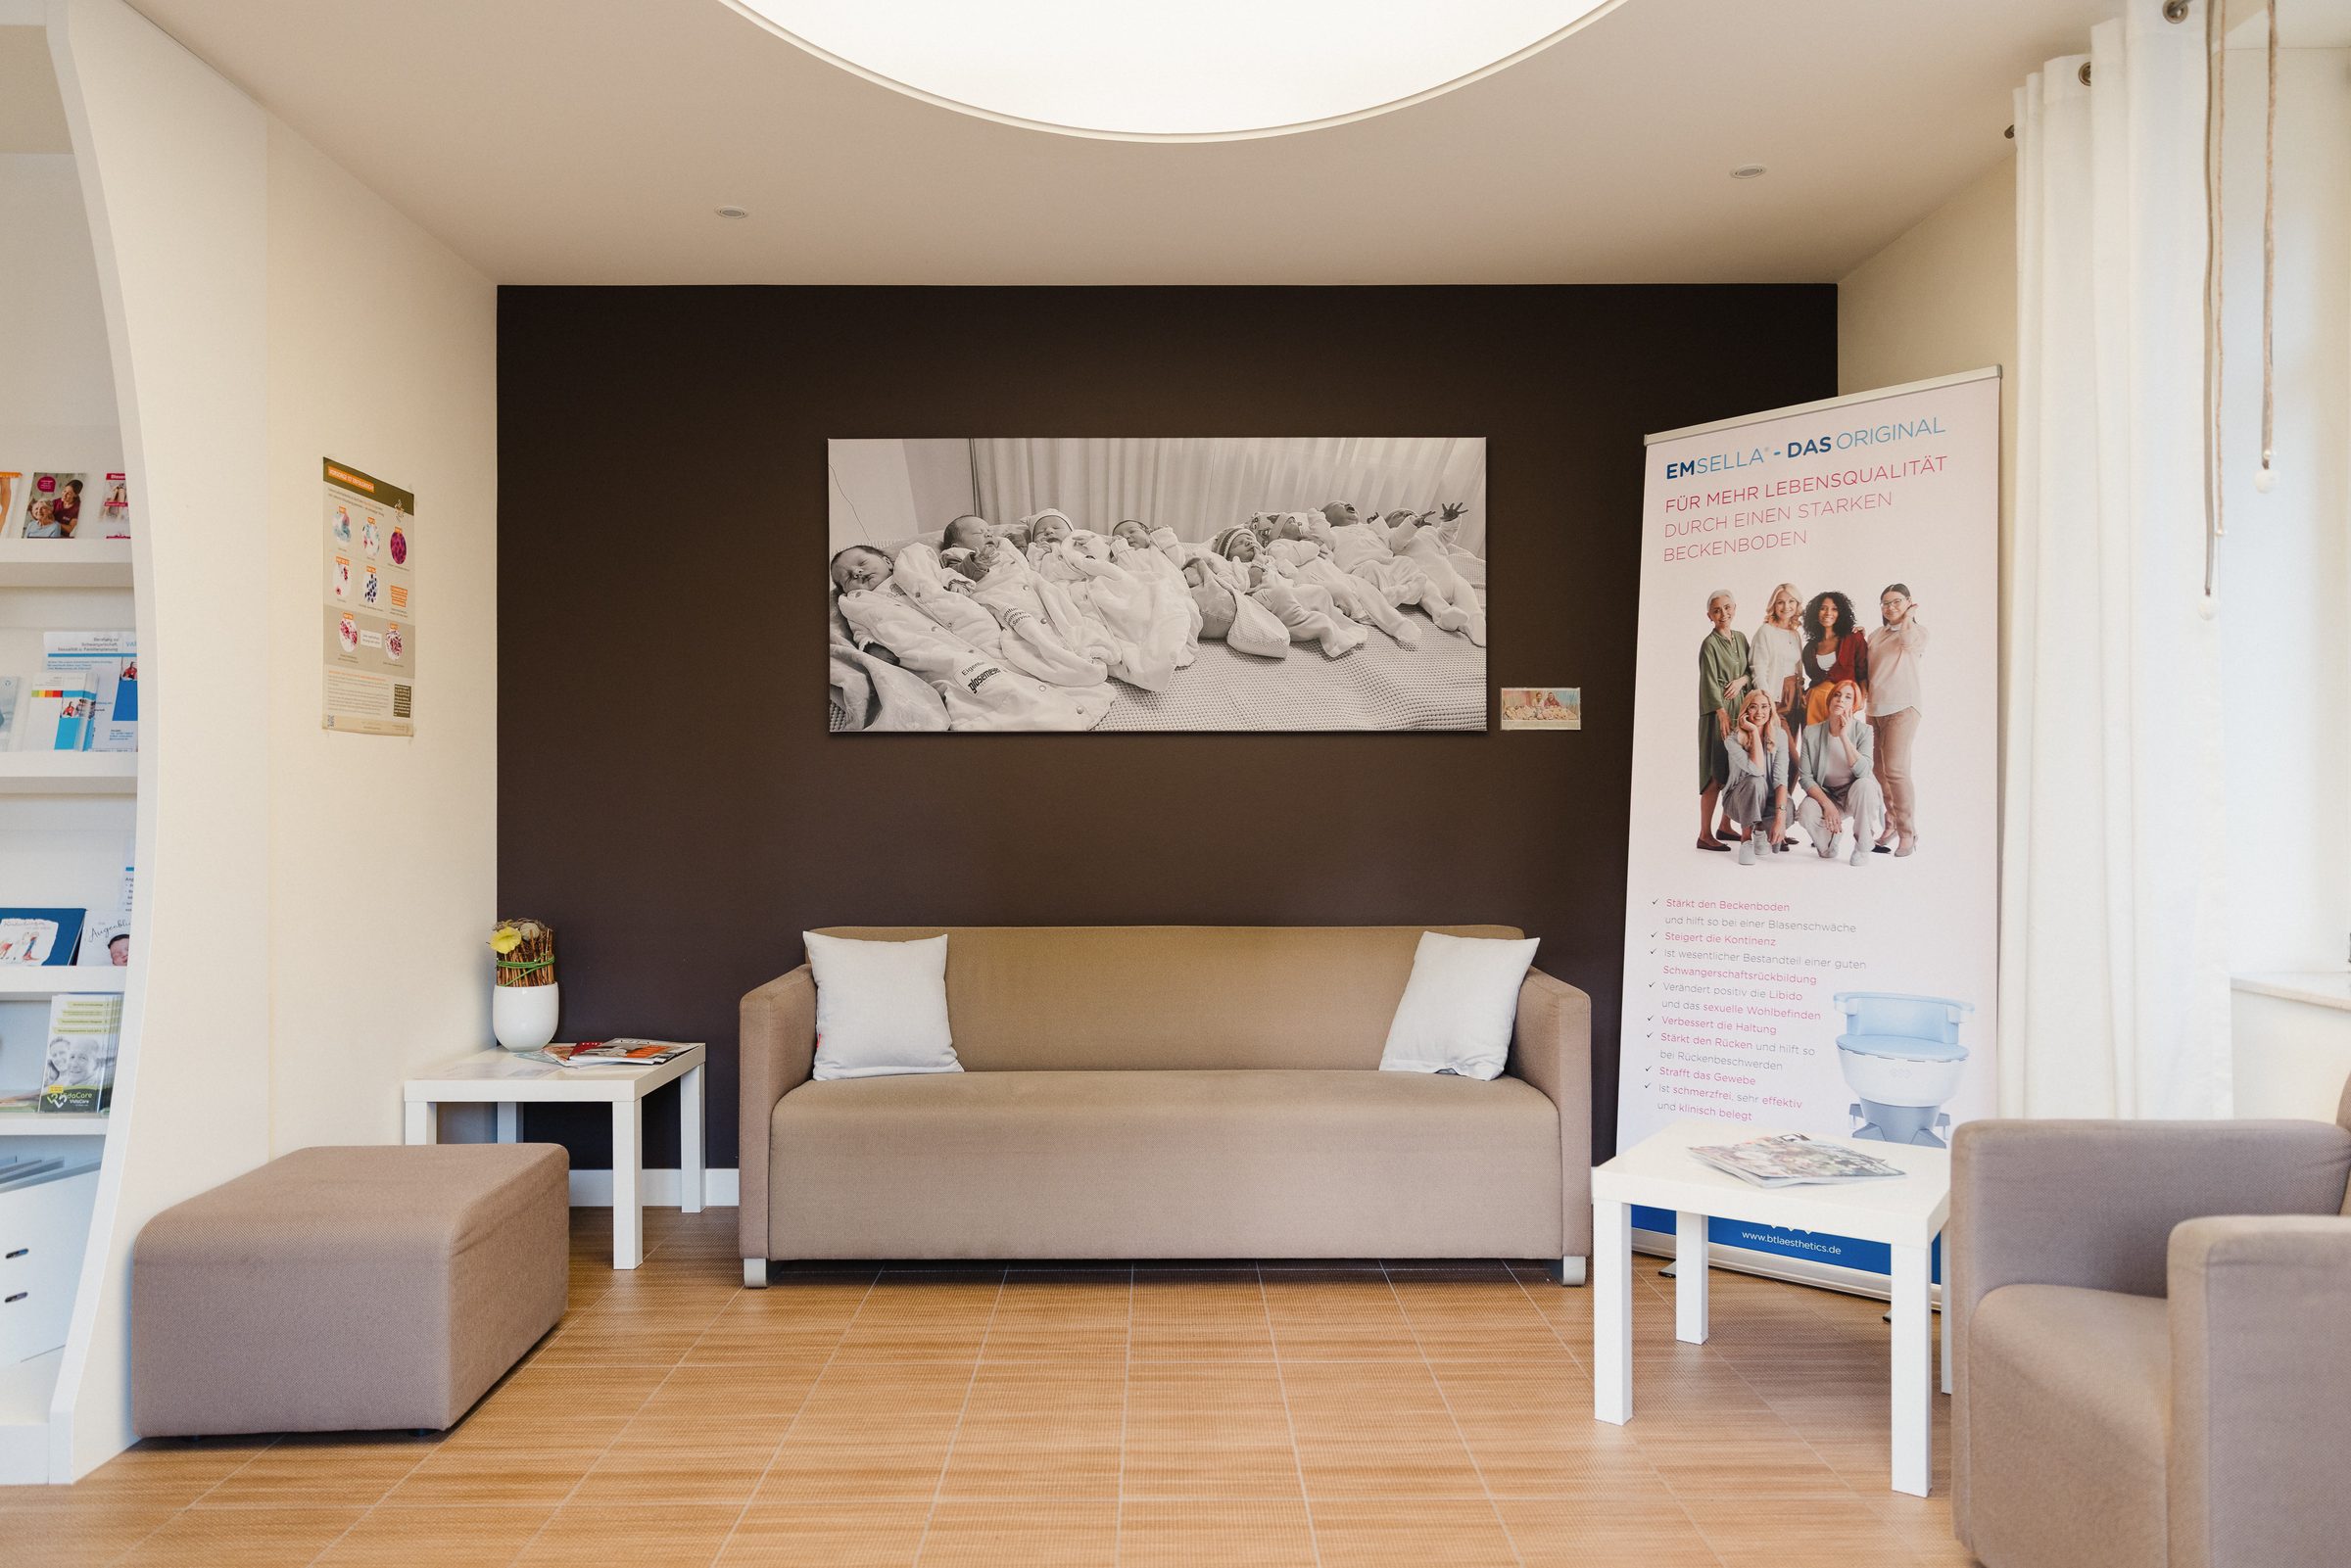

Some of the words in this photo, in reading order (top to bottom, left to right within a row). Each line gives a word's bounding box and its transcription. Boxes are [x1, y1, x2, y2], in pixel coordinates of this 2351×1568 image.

[1788, 437, 1832, 458] DAS
[1837, 417, 1946, 450] ORIGINAL
[1666, 495, 1701, 513] FÜR
[1706, 486, 1758, 507] MEHR
[1765, 455, 1947, 499] LEBENSQUALITÄT
[1665, 515, 1728, 538] DURCH
[1734, 506, 1791, 528] EINEN
[1798, 491, 1892, 519] STARKEN
[1664, 530, 1806, 562] BECKENBODEN
[1666, 898, 1695, 908] Stärkt
[1698, 900, 1716, 909] den
[1719, 900, 1790, 912] Beckenboden
[1665, 916, 1684, 925] und
[1686, 916, 1704, 926] hilft
[1721, 918, 1737, 927] bei
[1740, 920, 1765, 928] einer
[1768, 920, 1856, 933] Blasenschwäche
[1664, 931, 1703, 943] Steigert
[1706, 933, 1721, 943] die
[1724, 935, 1777, 947] Kontinenz
[1678, 950, 1740, 962] wesentlicher
[1743, 953, 1801, 966] Bestandteil
[1804, 958, 1831, 968] einer
[1835, 960, 1866, 971] guten
[1663, 965, 1817, 986] Schwangerschaftsrückbildung
[1663, 982, 1711, 994] Verändert
[1713, 986, 1748, 997] positiv
[1751, 988, 1766, 998] die
[1769, 990, 1803, 1001] Libido
[1661, 1000, 1681, 1009] und
[1683, 1001, 1701, 1011] das
[1703, 1003, 1744, 1014] sexuelle
[1747, 1006, 1821, 1020] Wohlbefinden
[1661, 1016, 1713, 1028] Verbessert
[1717, 1021, 1733, 1030] die
[1736, 1022, 1777, 1036] Haltung
[1660, 1032, 1691, 1044] Stärkt
[1693, 1035, 1712, 1045] den
[1715, 1037, 1753, 1050] Rücken
[1755, 1042, 1776, 1052] und
[1779, 1044, 1799, 1055] hilft
[1659, 1050, 1675, 1060] bei
[1678, 1051, 1783, 1070] Rückenbeschwerden
[1659, 1066, 1691, 1078] Strafft
[1693, 1070, 1711, 1080] das
[1713, 1072, 1756, 1086] Gewebe
[1737, 1093, 1759, 1103] sehr
[1761, 1096, 1802, 1109] effektiv
[1657, 1102, 1676, 1112] und
[1678, 1103, 1716, 1117] klinisch
[1718, 1108, 1752, 1122] belegt
[1742, 1231, 1842, 1256] www.btlaesthetics.de
